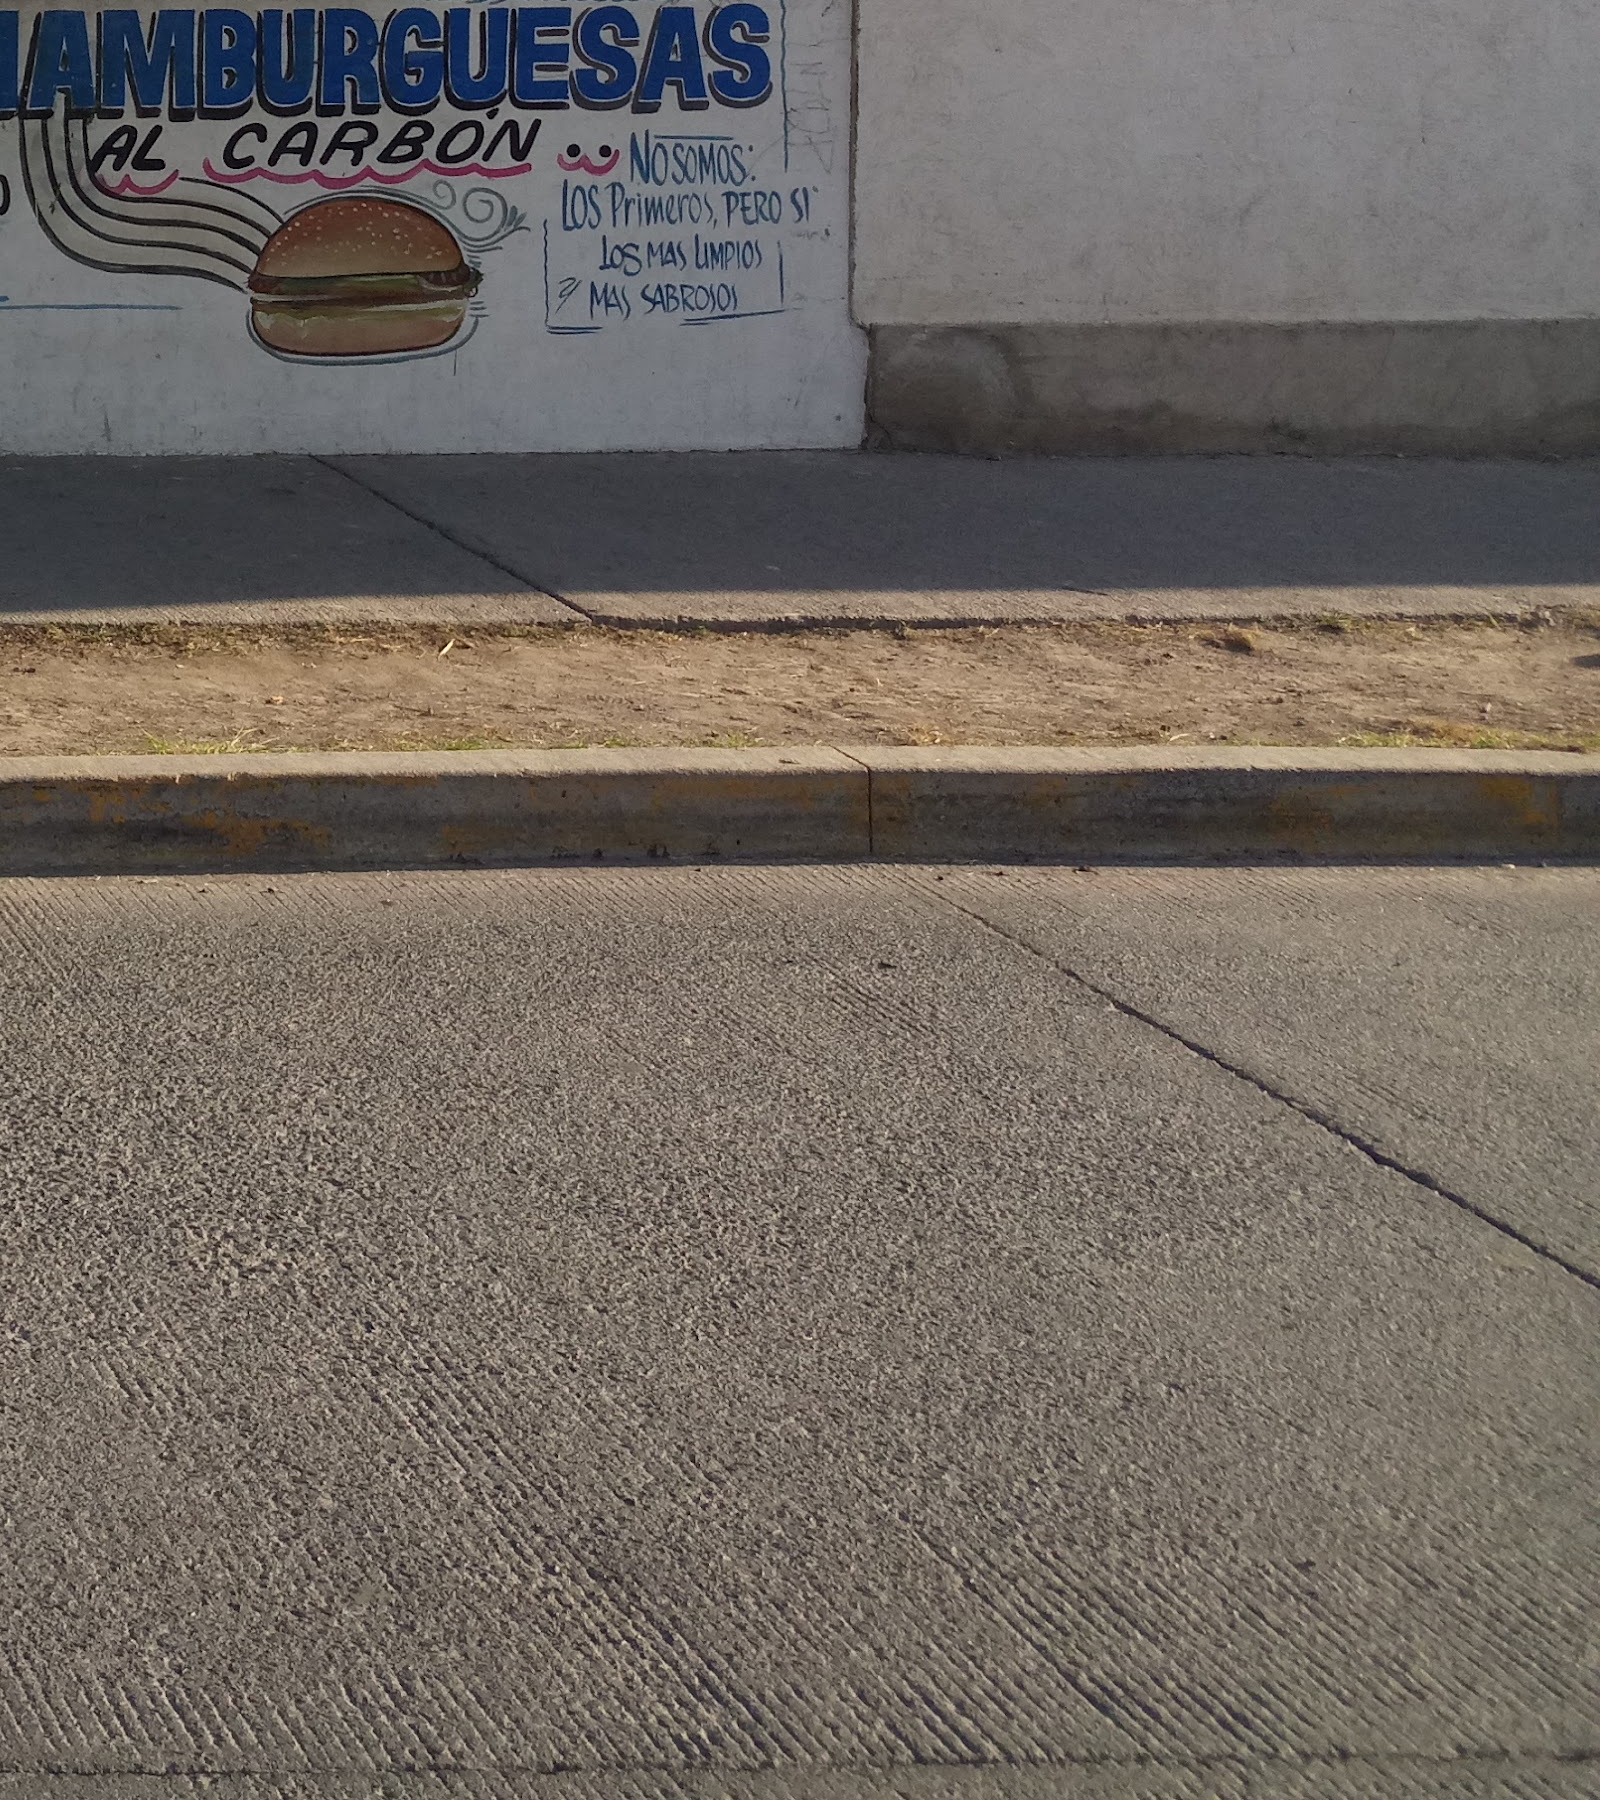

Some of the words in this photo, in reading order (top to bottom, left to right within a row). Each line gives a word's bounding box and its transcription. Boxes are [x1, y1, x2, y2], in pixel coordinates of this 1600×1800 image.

[95, 123, 167, 172] AL
[561, 178, 602, 232] LOS
[720, 190, 783, 229] PERO
[598, 234, 644, 277] LOS
[646, 240, 688, 272] MAS
[693, 232, 764, 271] LIMPIOS
[589, 280, 632, 321] MAS
[639, 281, 739, 316] SABROSOS
